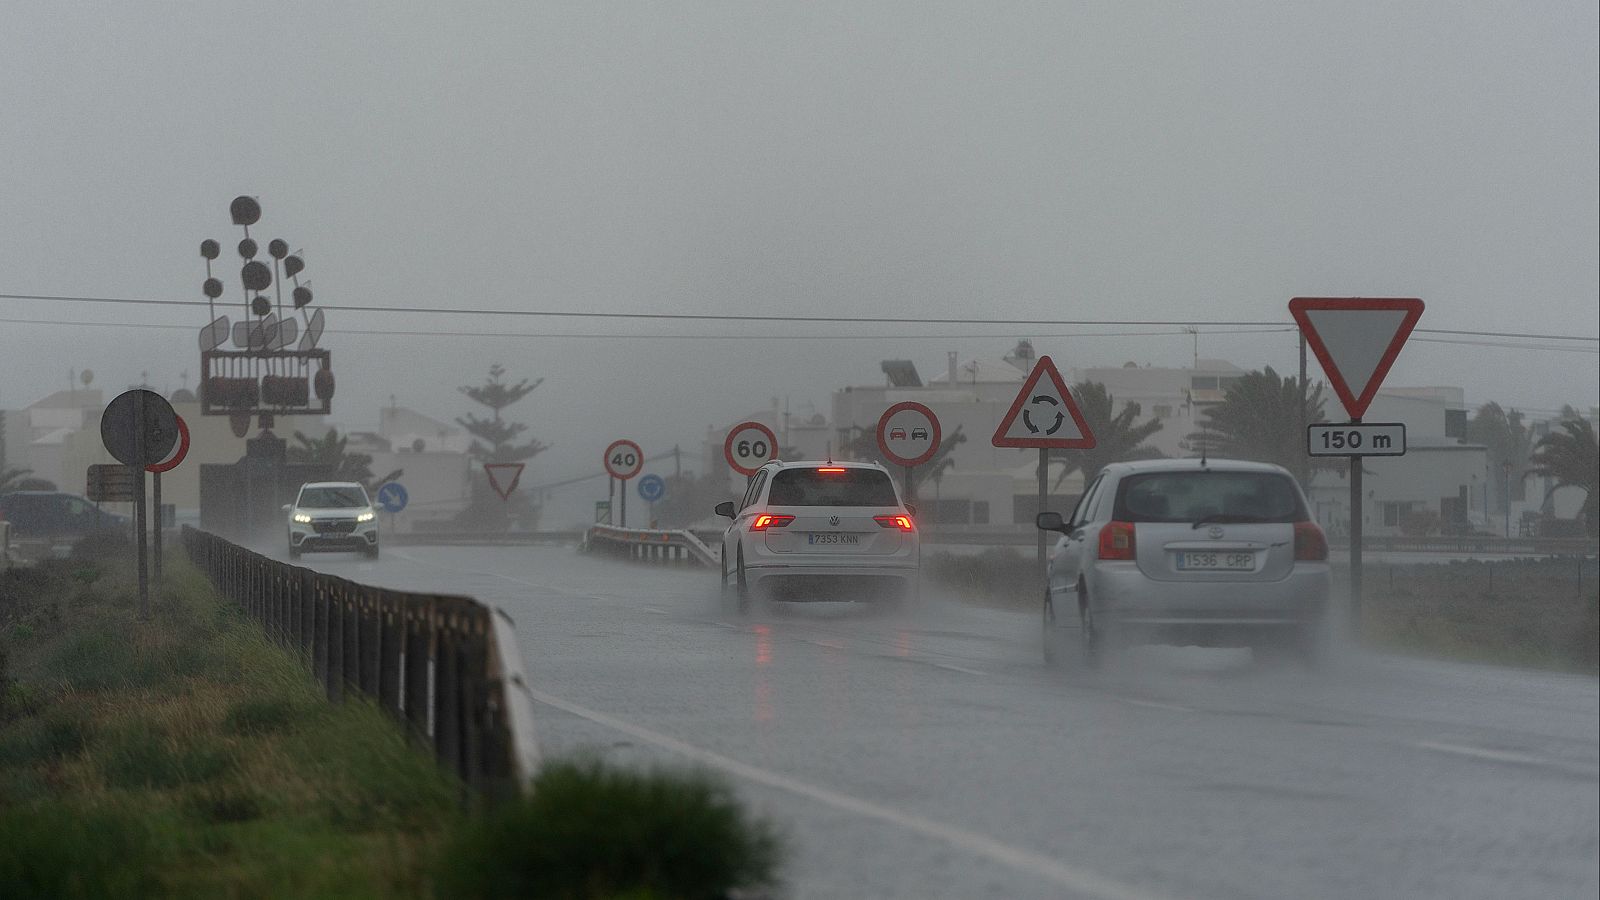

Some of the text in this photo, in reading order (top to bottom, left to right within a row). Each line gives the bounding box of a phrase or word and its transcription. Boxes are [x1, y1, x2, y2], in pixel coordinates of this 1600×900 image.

[1322, 431, 1391, 449] 150 m
[738, 440, 767, 458] 60
[612, 453, 636, 466] 40
[815, 534, 859, 544] 7353 KNN
[1185, 553, 1253, 568] 1536 CRP
